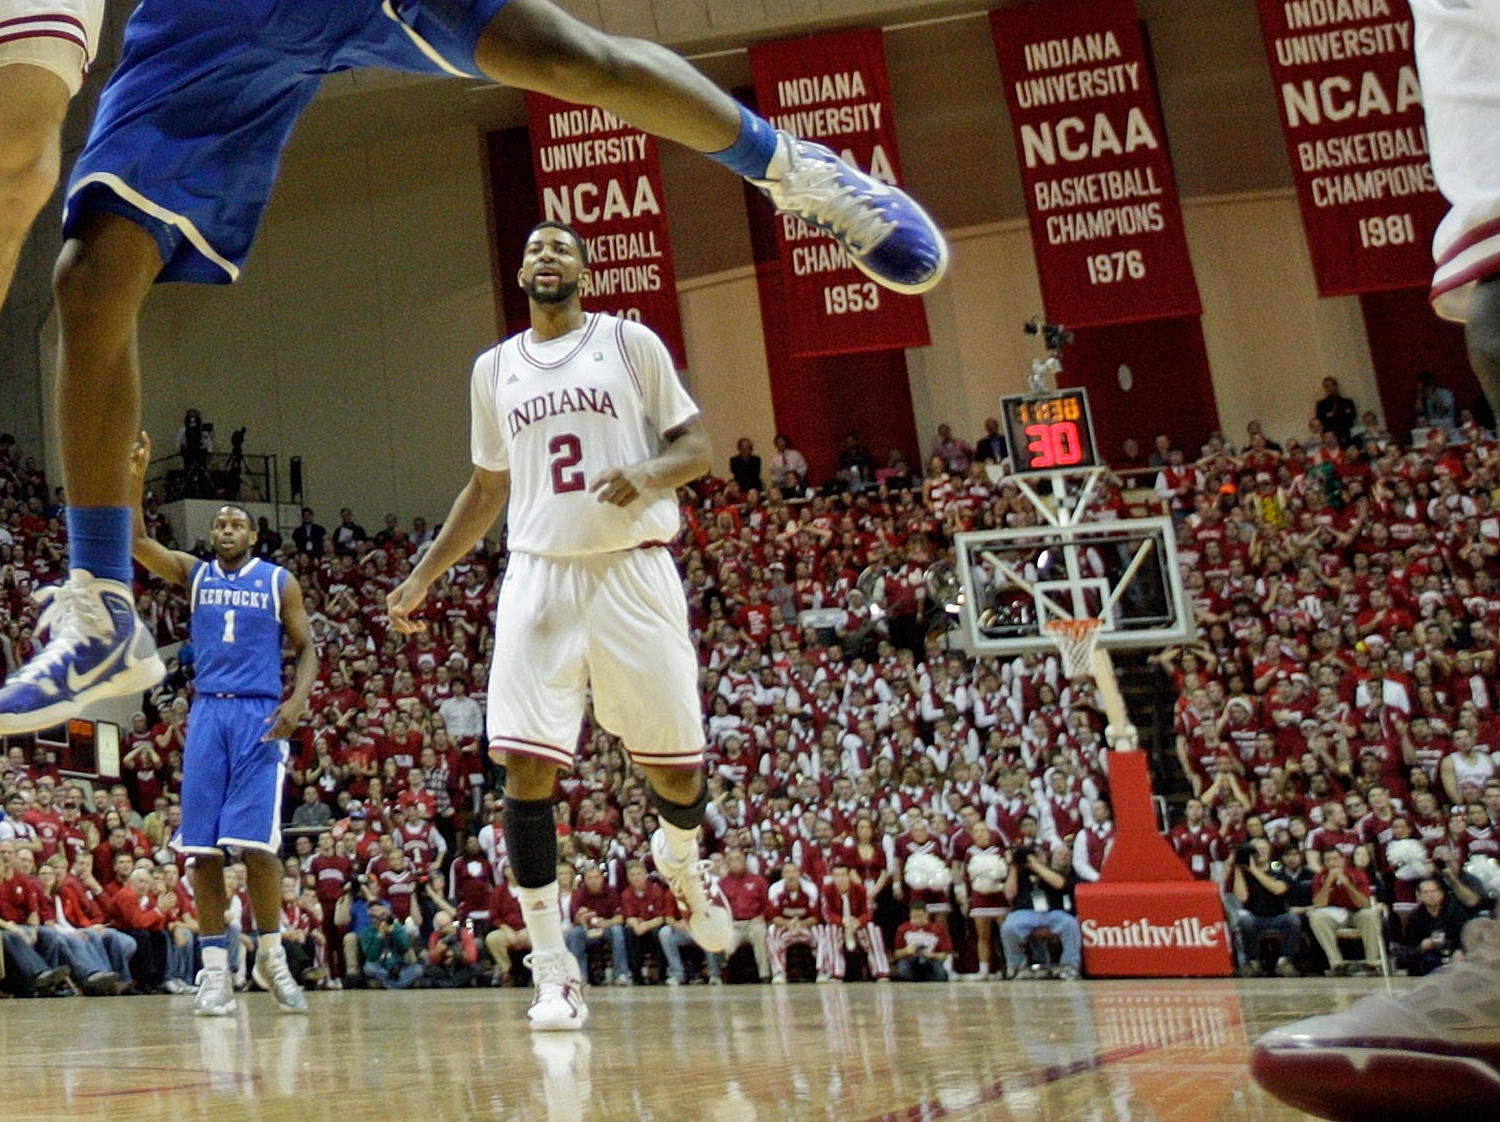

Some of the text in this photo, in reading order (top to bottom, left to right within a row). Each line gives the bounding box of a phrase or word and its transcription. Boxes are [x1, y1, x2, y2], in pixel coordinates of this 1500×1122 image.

[1023, 30, 1121, 72] INDIANA
[1275, 20, 1411, 67] UNIVERSITY
[777, 70, 867, 108] INDIANA
[1015, 62, 1140, 109] UNIVERSITY
[1281, 65, 1424, 128] NCAA
[549, 107, 632, 140] INDIAN
[1020, 107, 1158, 169] NCAA
[540, 133, 647, 173] UNIVERSITY
[543, 175, 660, 226] NCAA
[1034, 166, 1162, 211] BASKETBALL
[1311, 162, 1437, 209] CHAMPIONS
[1045, 202, 1165, 245] CHAMPIONS
[1358, 213, 1415, 249] 1981
[583, 231, 662, 264] KETBALL
[1086, 249, 1146, 284] 1976
[579, 264, 662, 296] AMPIONS
[824, 282, 880, 315] 1953
[507, 387, 619, 440] INDIANA
[548, 433, 586, 495] 2
[1025, 421, 1082, 468] 30
[199, 588, 270, 610] KENTUCKY
[222, 609, 236, 644] 1
[1080, 916, 1220, 948] Smithville
